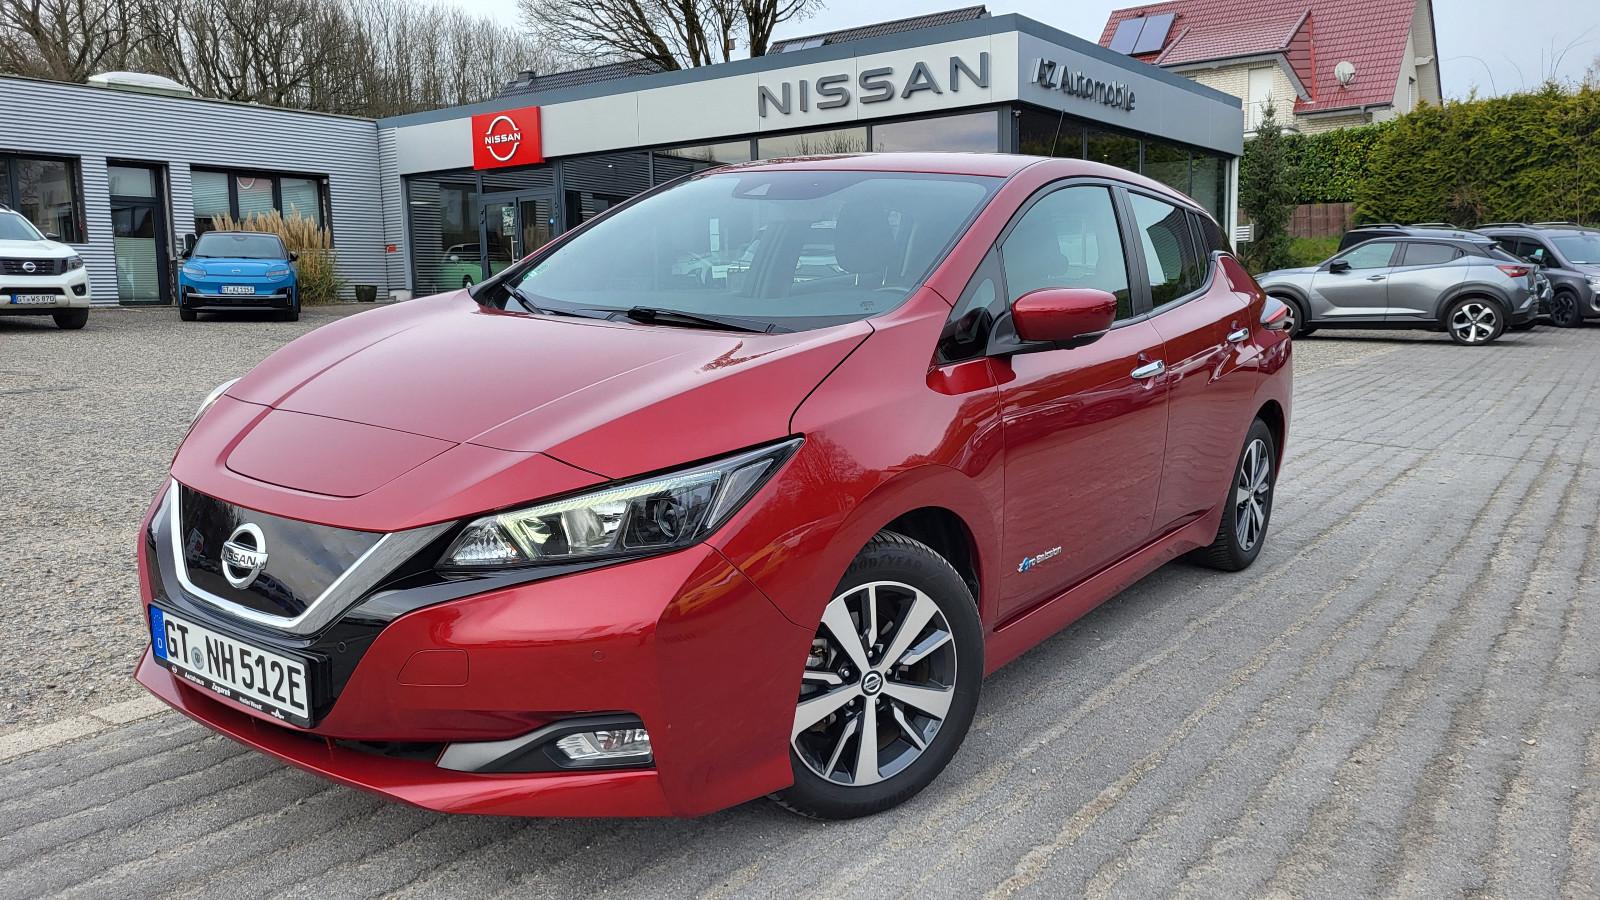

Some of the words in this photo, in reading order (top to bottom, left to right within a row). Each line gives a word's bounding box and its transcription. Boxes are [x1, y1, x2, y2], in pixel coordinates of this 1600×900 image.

[758, 51, 989, 118] NISSAN
[1032, 57, 1057, 88] AZ
[1056, 64, 1136, 111] Automobile
[484, 132, 521, 145] NISSAN
[16, 295, 27, 303] GT
[164, 619, 189, 664] GT
[205, 635, 236, 684] NH
[239, 647, 305, 711] 512E
